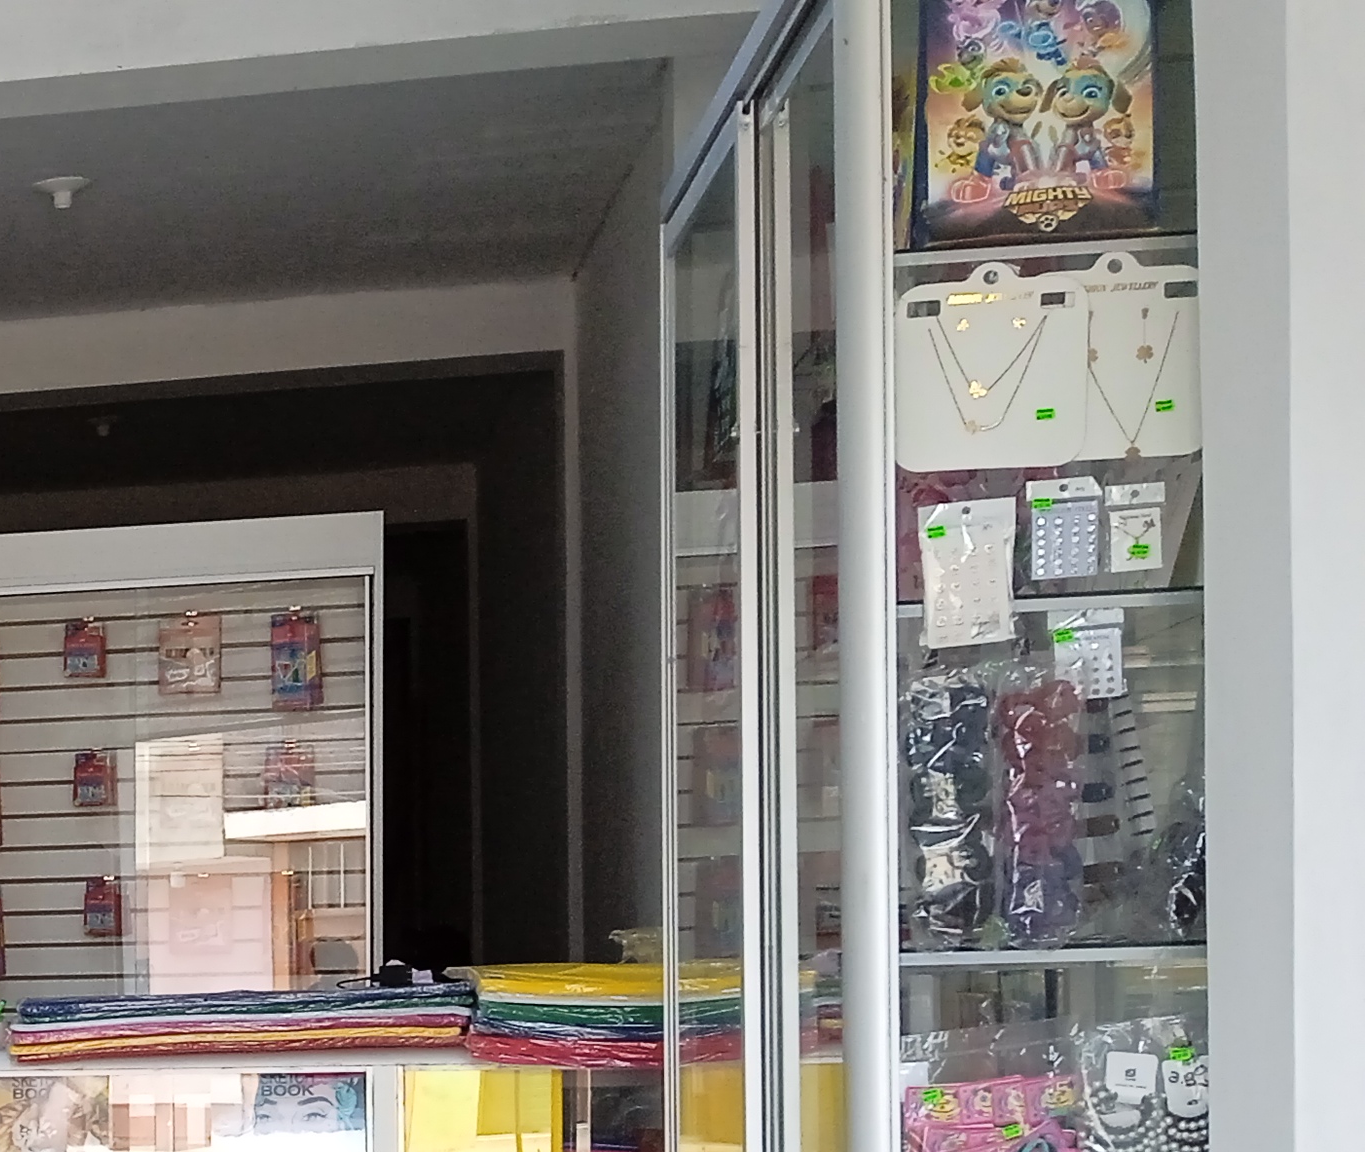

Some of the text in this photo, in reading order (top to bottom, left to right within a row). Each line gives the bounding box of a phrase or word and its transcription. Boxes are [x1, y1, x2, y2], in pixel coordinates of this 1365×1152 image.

[1005, 186, 1092, 205] MIGHTY
[13, 1088, 49, 1099] BOO
[261, 1085, 314, 1096] BOOK
